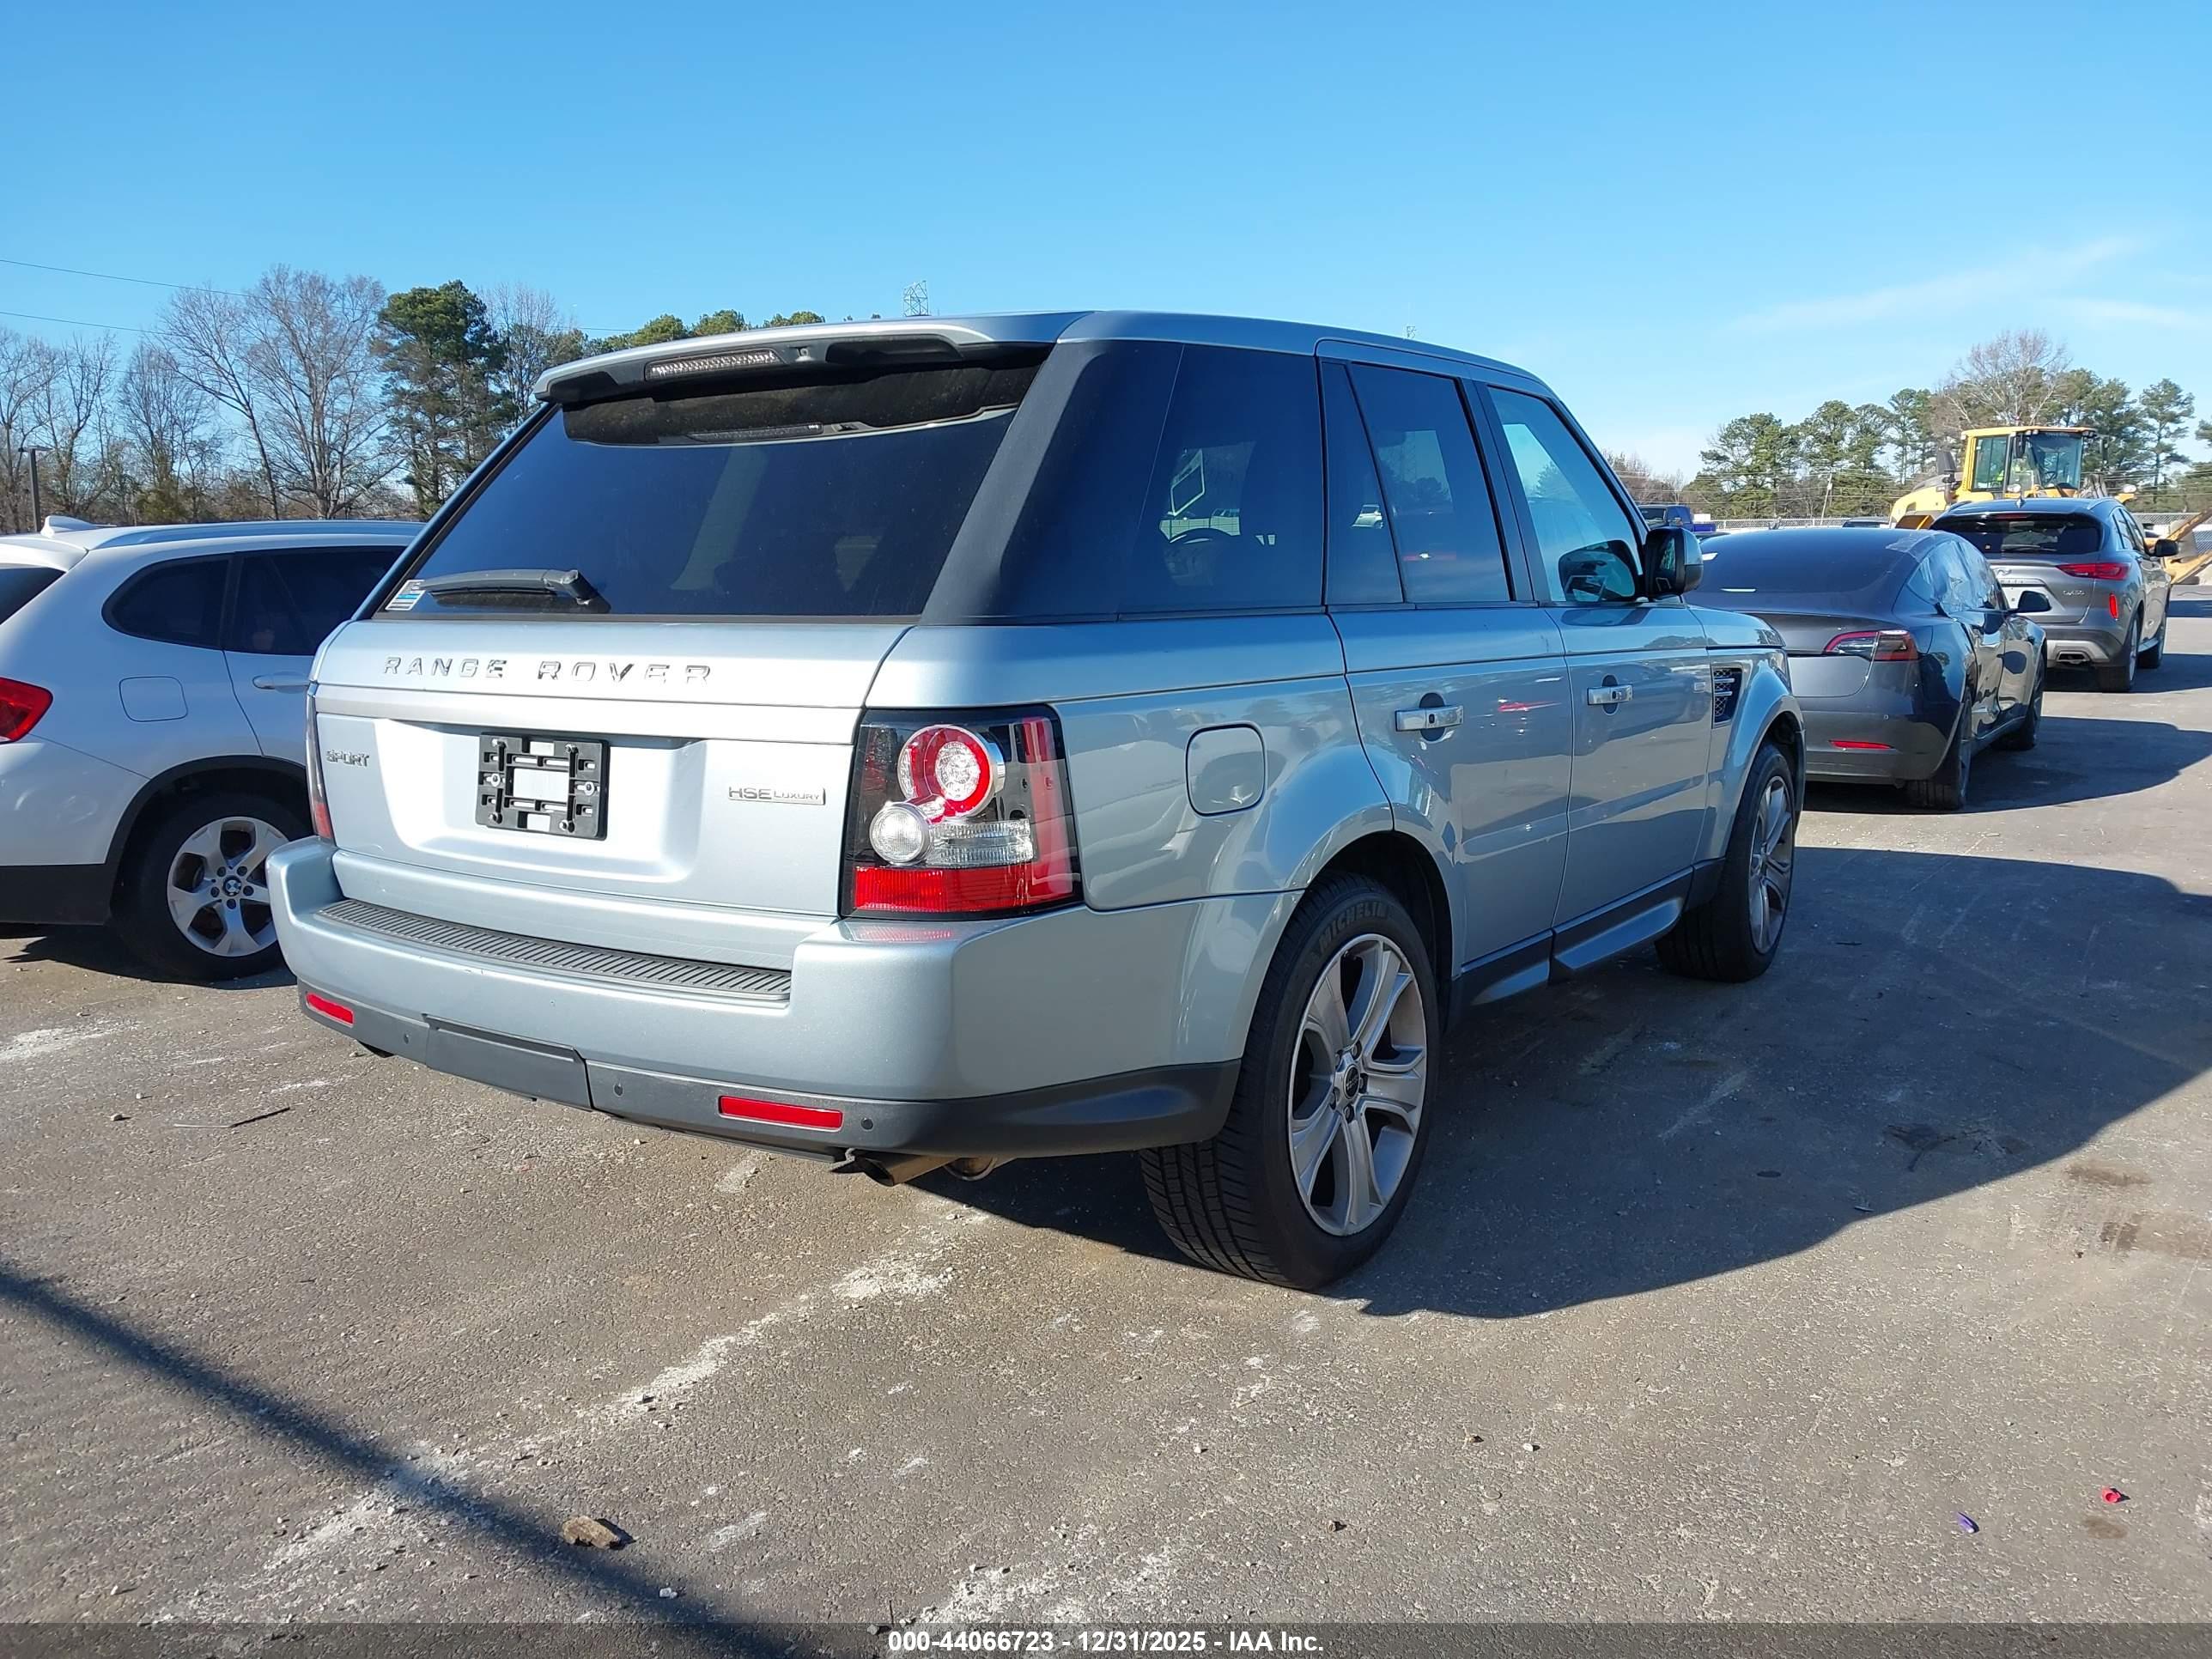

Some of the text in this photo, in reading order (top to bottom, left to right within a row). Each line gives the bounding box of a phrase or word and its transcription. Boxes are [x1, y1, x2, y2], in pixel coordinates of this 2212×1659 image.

[383, 656, 711, 684] RANGE ROVER
[326, 750, 369, 767] SPORT
[728, 787, 772, 799] HSE
[1318, 902, 1389, 952] MICHELIN
